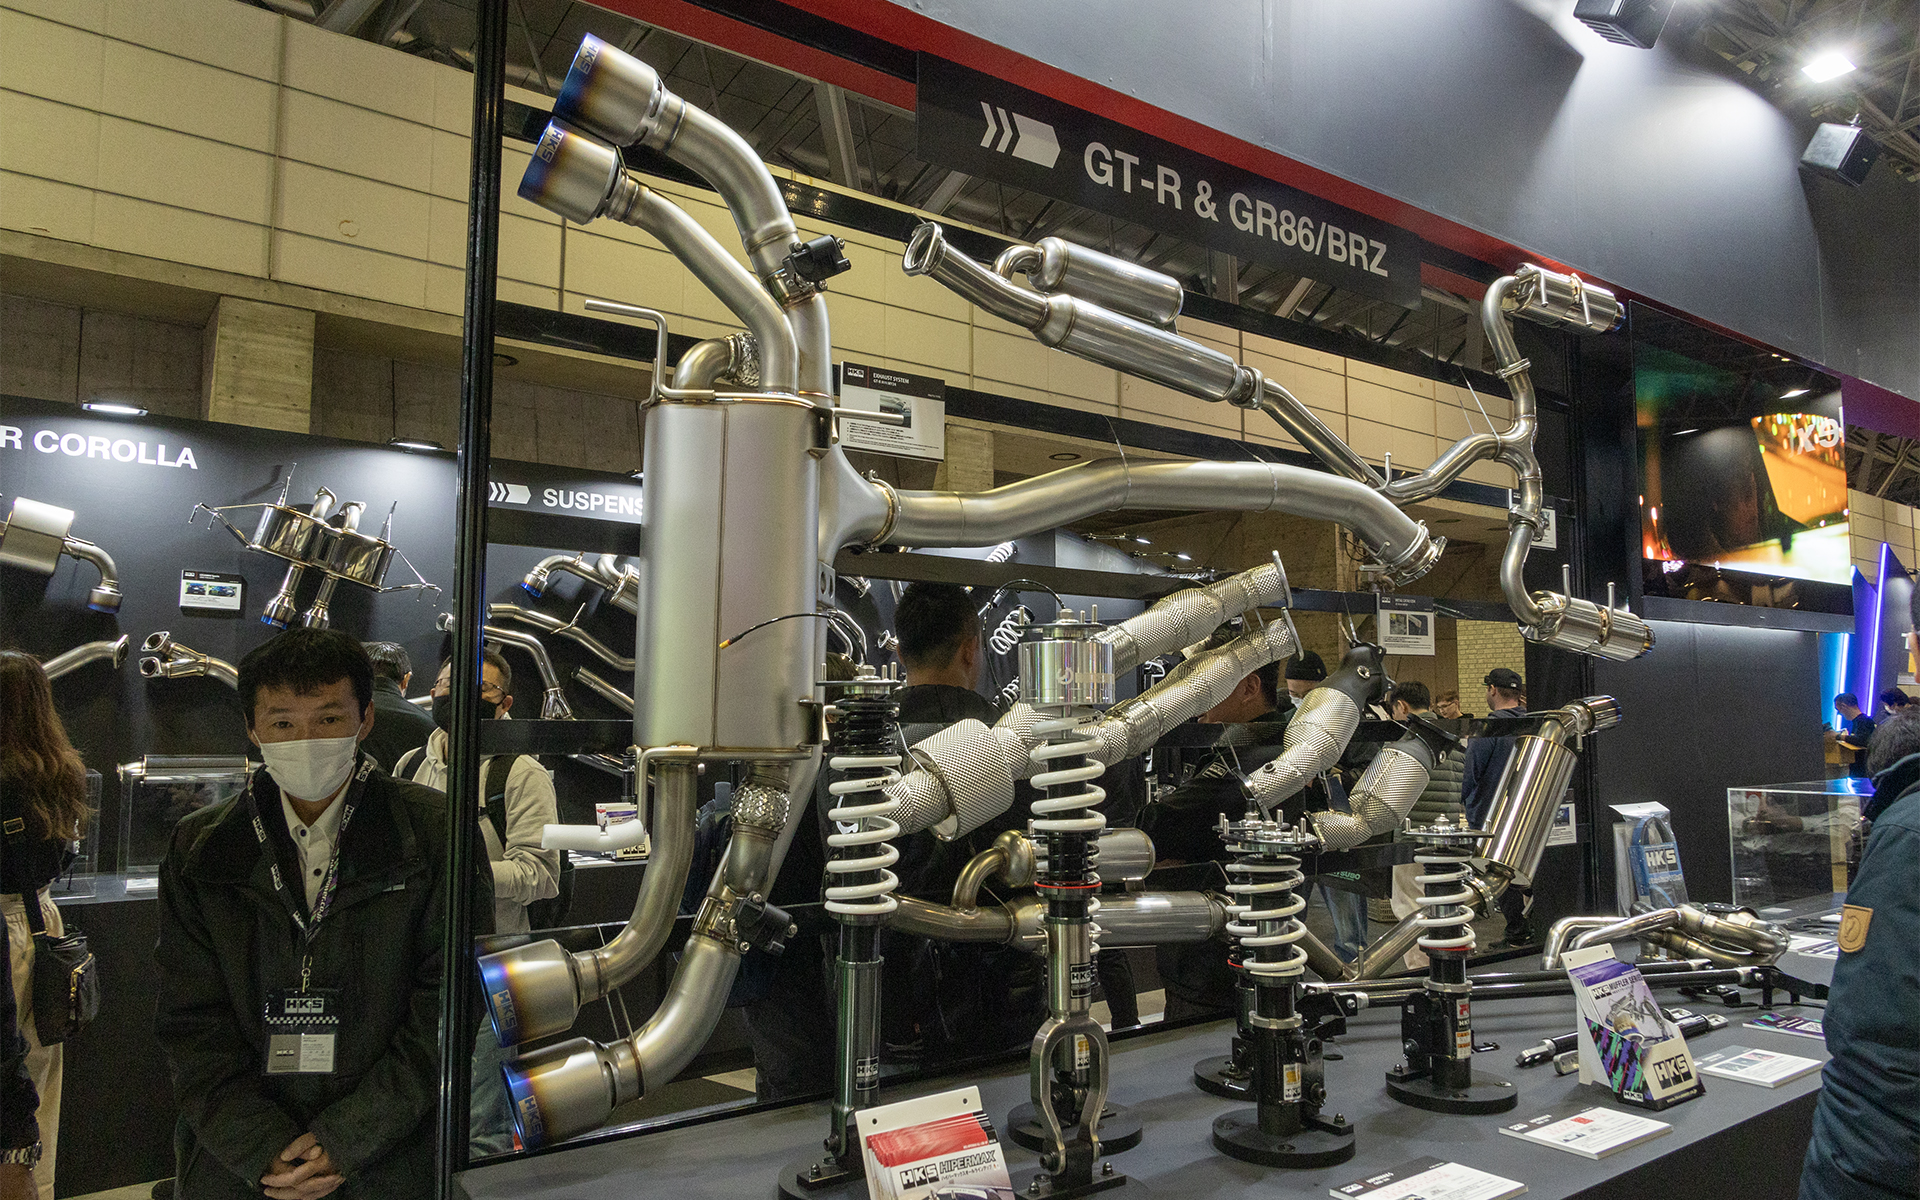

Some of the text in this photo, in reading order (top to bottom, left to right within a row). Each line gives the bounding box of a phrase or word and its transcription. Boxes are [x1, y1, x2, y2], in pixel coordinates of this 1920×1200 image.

[577, 41, 600, 75] HKS
[539, 127, 565, 163] HKS
[1083, 141, 1388, 277] GT-R & GR86/BRZ
[0, 425, 198, 470] R COROLLA
[543, 488, 643, 517] SUSPENS
[1645, 849, 1677, 871] HKS
[285, 998, 324, 1013] HKS
[1592, 983, 1611, 999] HKS
[496, 989, 517, 1030] HKS
[1653, 1054, 1693, 1088] HKS
[1624, 1090, 1643, 1101] HKS
[521, 1095, 543, 1138] HKS
[900, 1150, 997, 1190] HKS HIPERMAX
